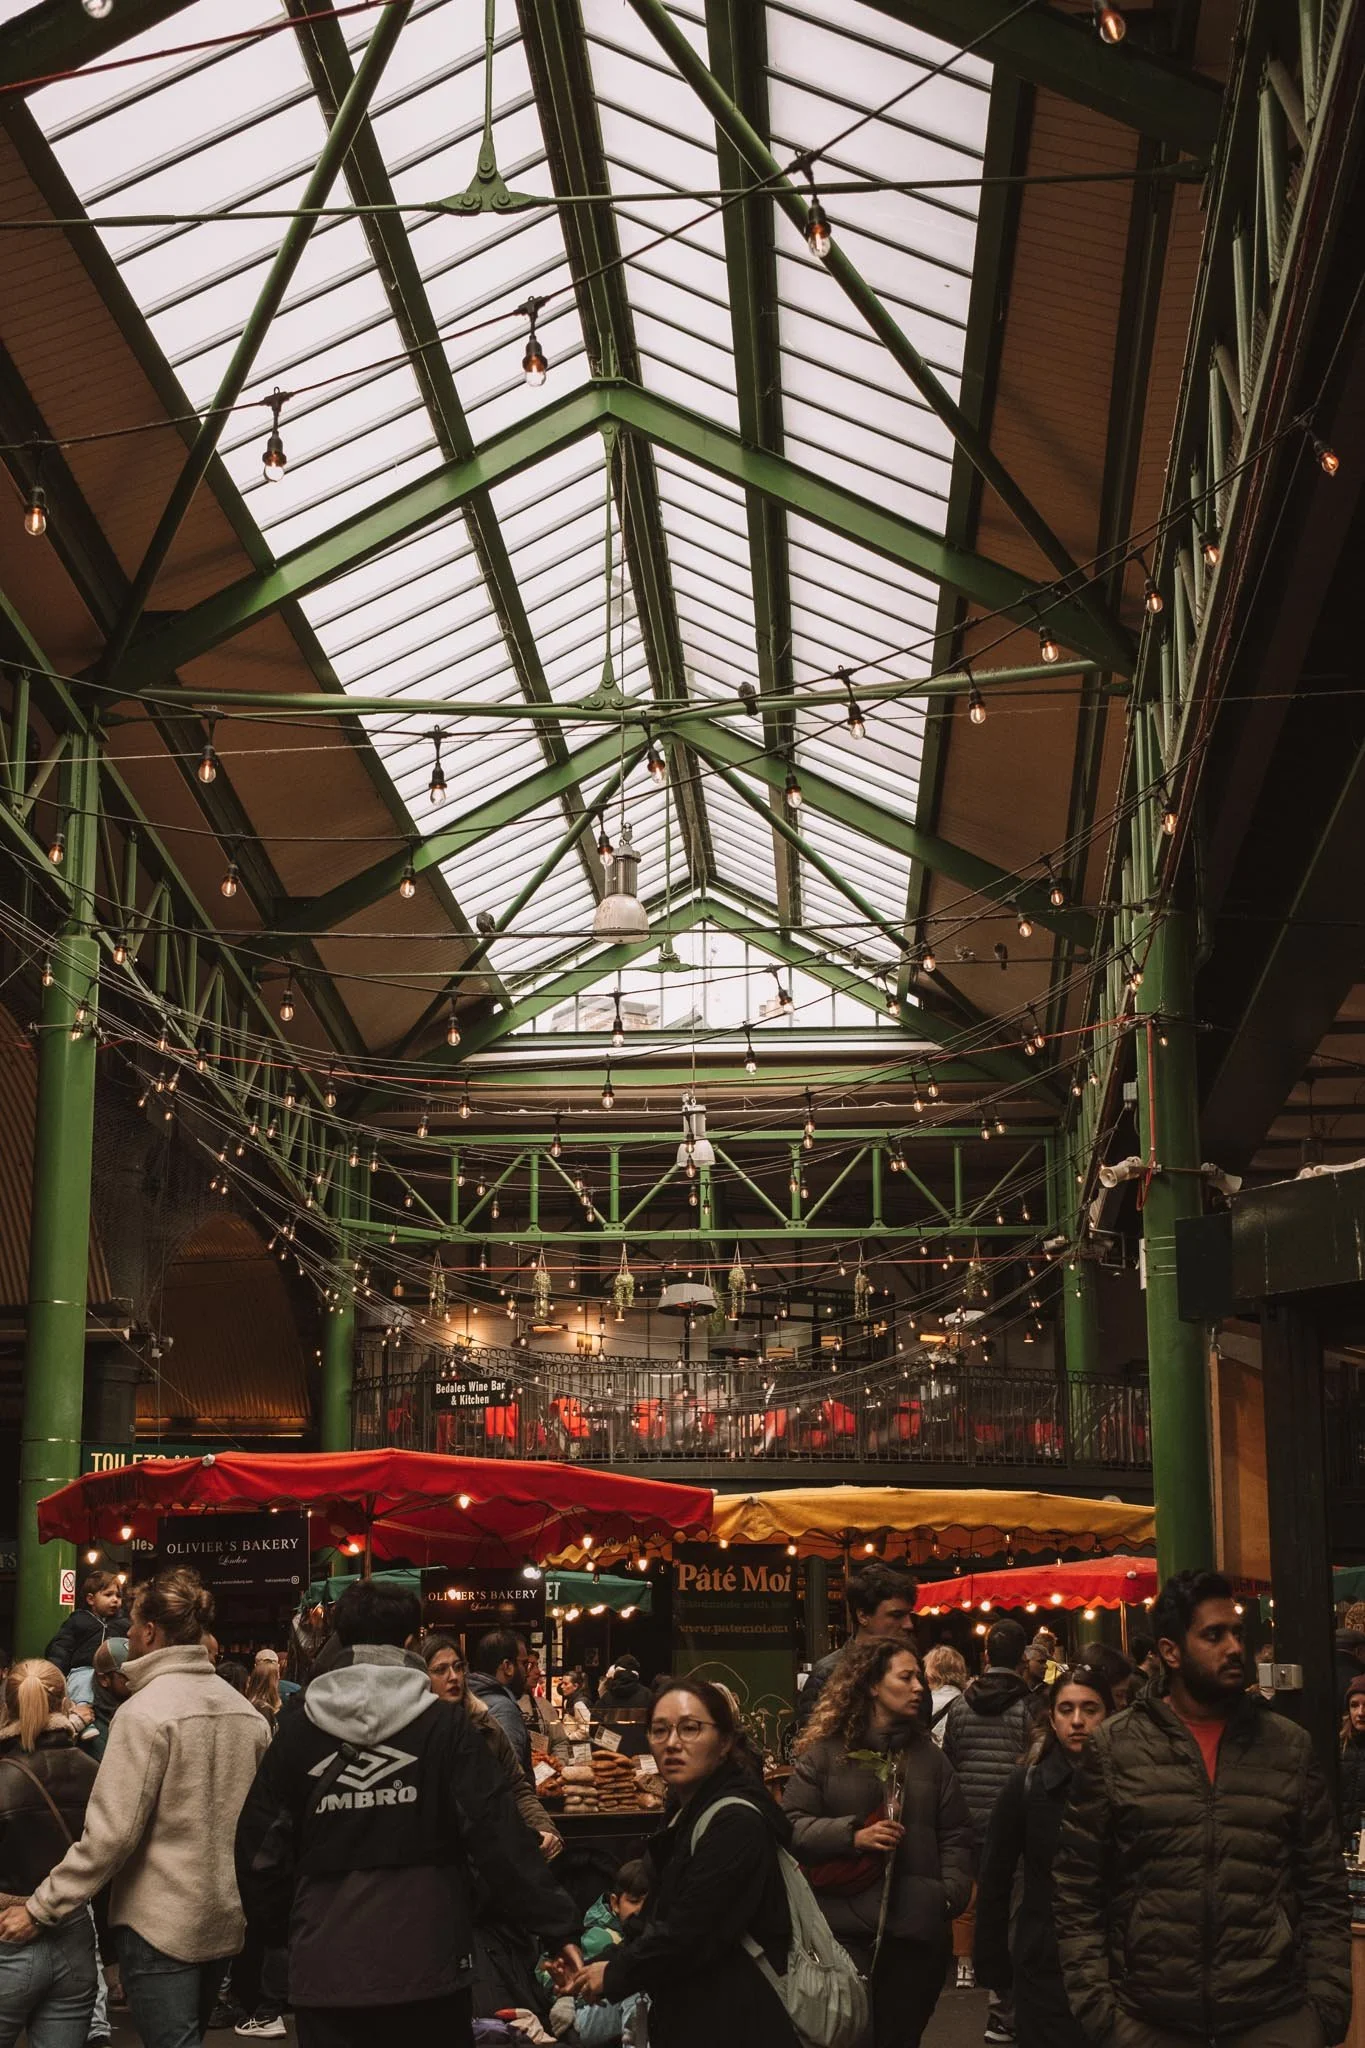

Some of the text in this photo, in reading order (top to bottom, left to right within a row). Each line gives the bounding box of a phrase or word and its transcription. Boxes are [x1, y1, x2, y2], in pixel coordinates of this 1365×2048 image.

[436, 1380, 506, 1394] Bedales Wine Bar
[451, 1394, 490, 1406] & Kitchen
[91, 1452, 166, 1473] TOILE
[166, 1538, 300, 1554] OLIVIER'S BAKERY
[678, 1564, 792, 1592] Pâté Moi
[428, 1589, 538, 1602] OLIER'S BAKERY
